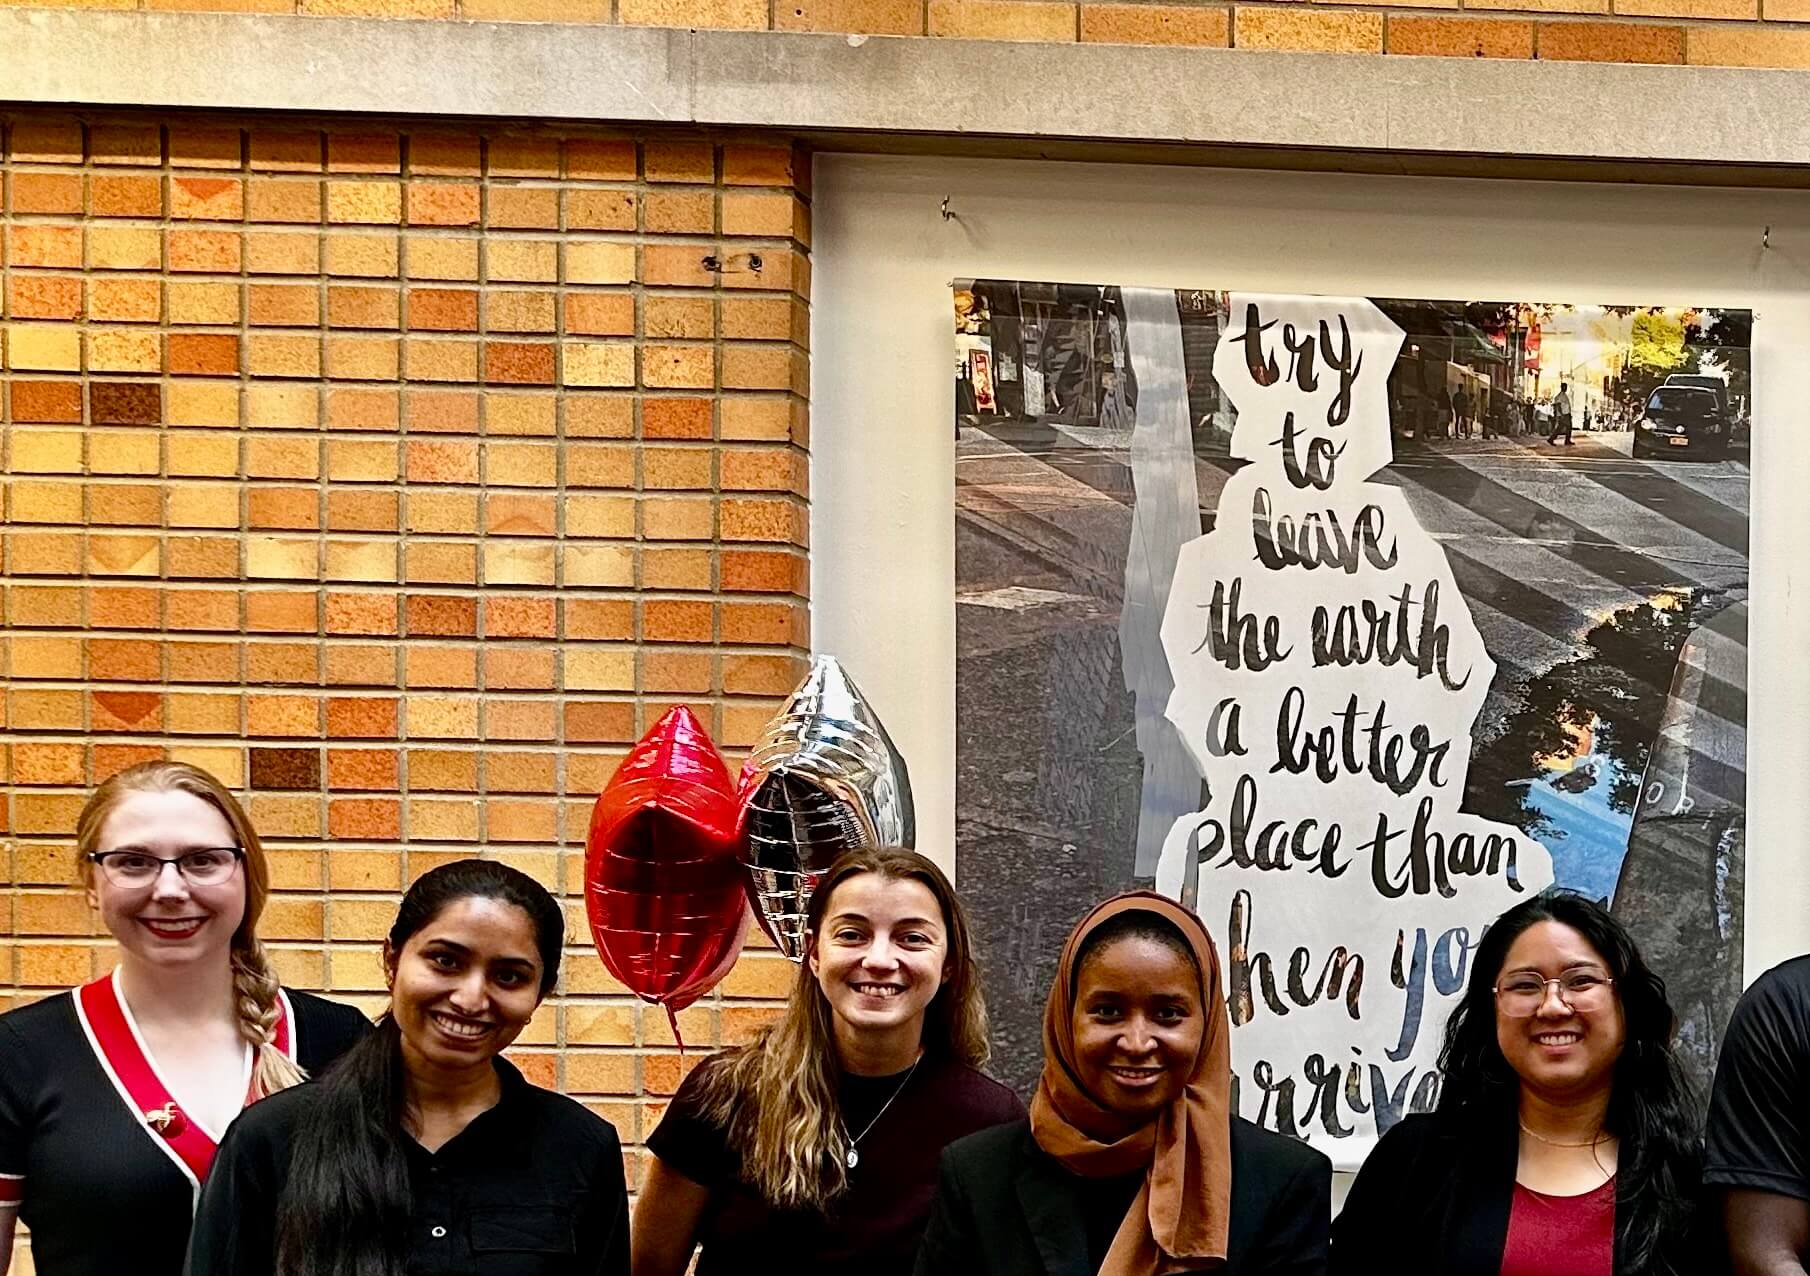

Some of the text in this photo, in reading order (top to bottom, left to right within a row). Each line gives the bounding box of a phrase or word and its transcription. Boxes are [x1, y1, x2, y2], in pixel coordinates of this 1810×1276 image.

[1230, 303, 1363, 425] try
[1267, 412, 1347, 491] to
[1252, 487, 1398, 574] leave
[1192, 577, 1473, 692] the earth
[1207, 686, 1452, 794] a better
[1181, 774, 1526, 912] place than
[1226, 888, 1491, 1063] hen yo
[1231, 1046, 1445, 1142] rrive
